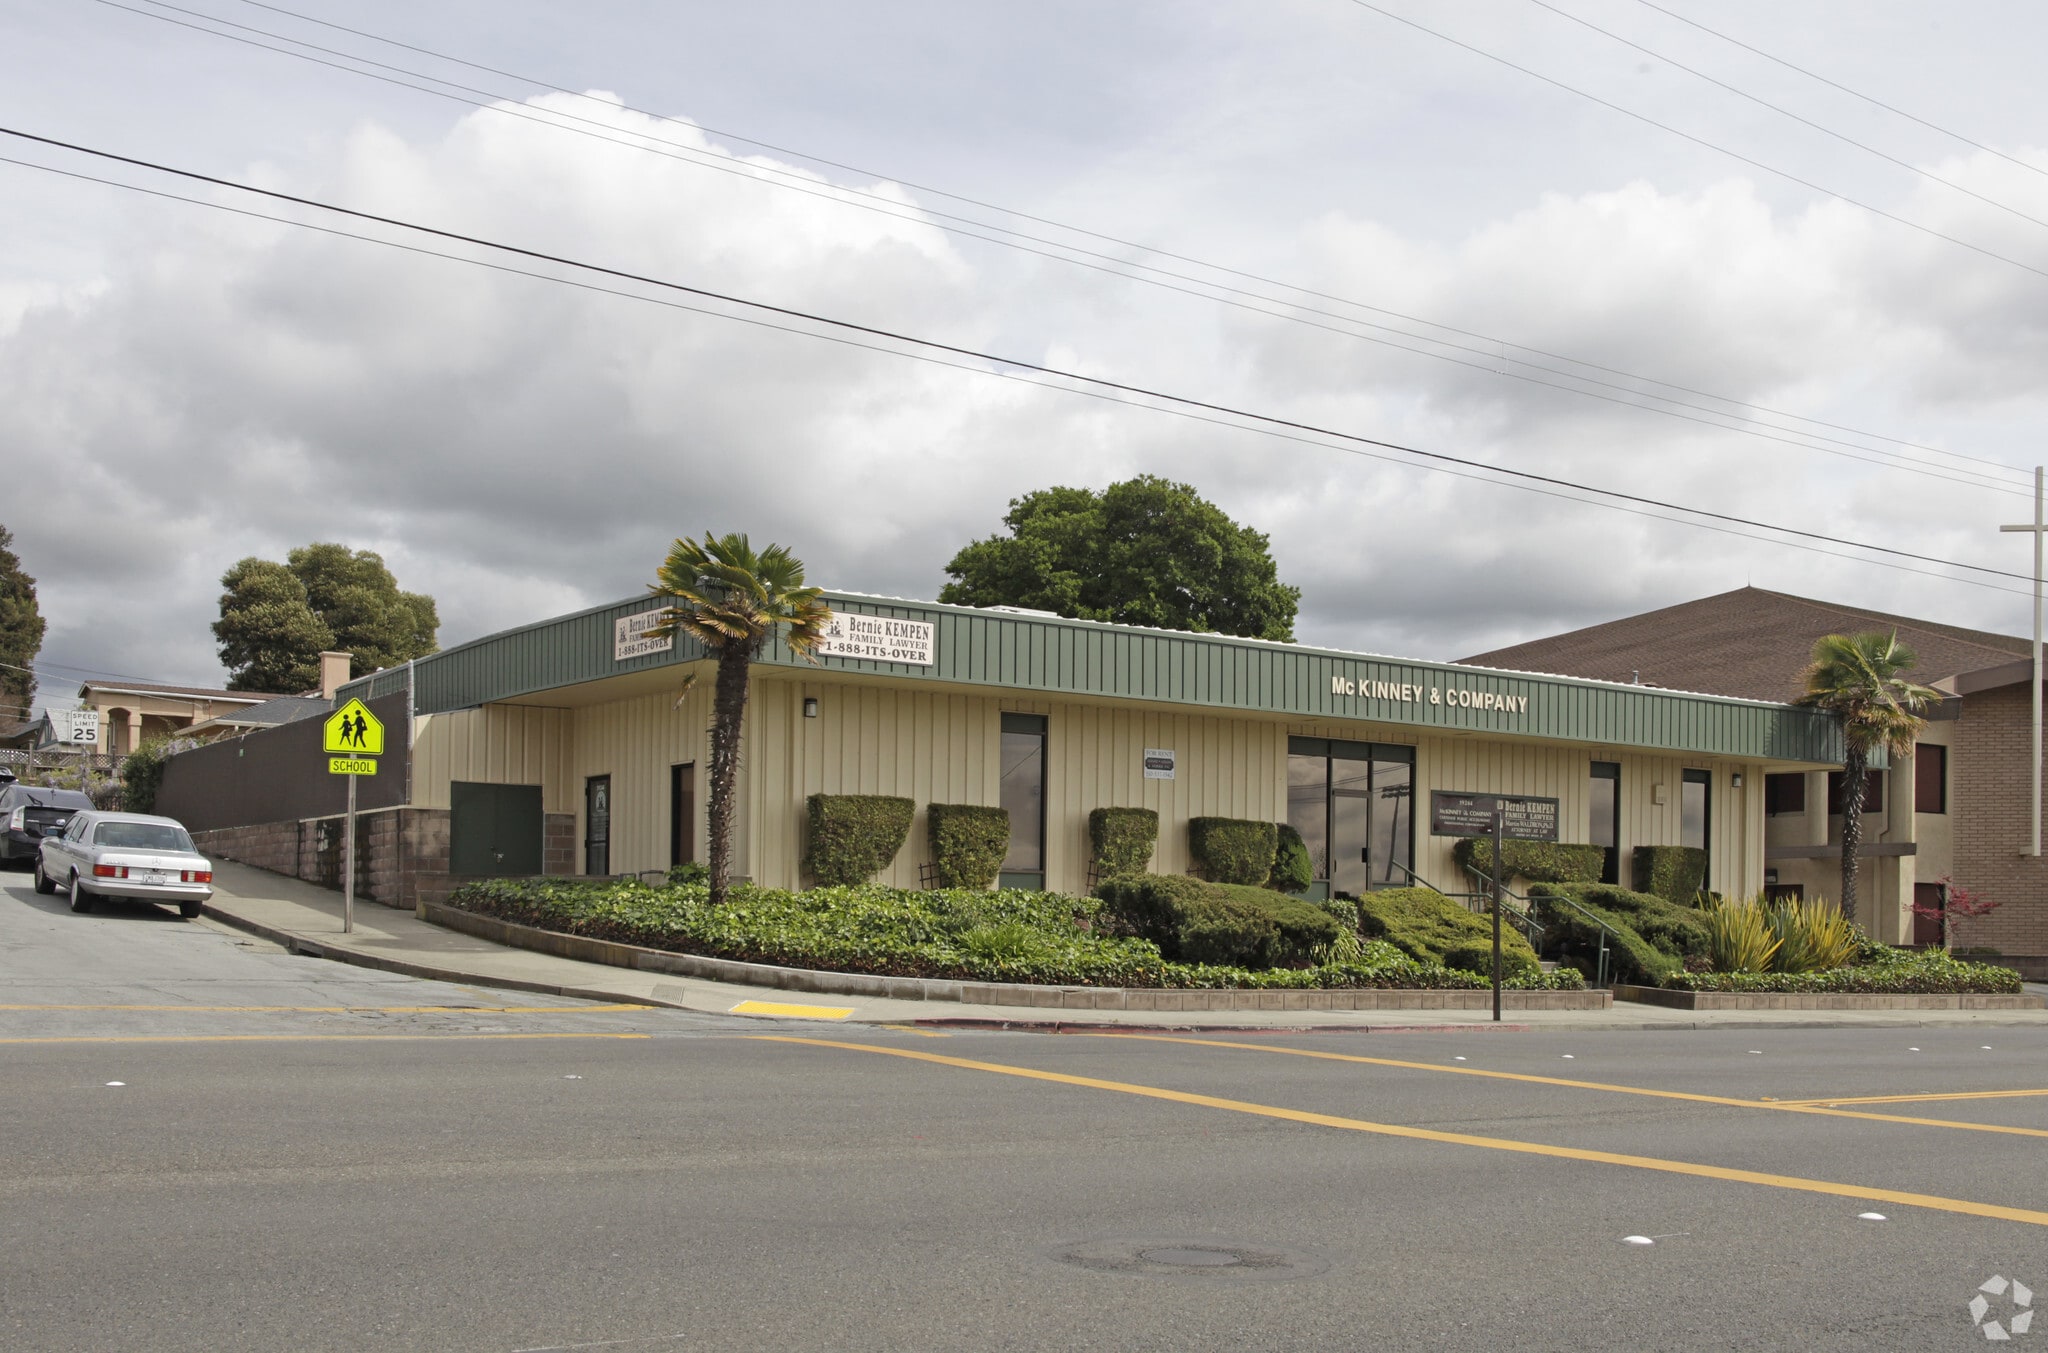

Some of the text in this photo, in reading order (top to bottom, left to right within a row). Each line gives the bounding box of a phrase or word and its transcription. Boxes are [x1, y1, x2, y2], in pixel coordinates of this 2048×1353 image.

[630, 616, 646, 633] Bernie
[850, 617, 929, 640] Bernie KEMPEN
[619, 639, 668, 657] 1-888-ITS-OVER
[850, 633, 928, 650] FAMILY LAWYER
[826, 641, 927, 661] 1-888-ITS-OVER
[1429, 687, 1440, 705] &
[1446, 689, 1527, 713] COMPANY
[73, 728, 95, 740] 25
[333, 760, 373, 772] SCHOOL
[1505, 800, 1555, 814] Bernie KEMPEN
[1505, 811, 1526, 819] FAMILY
